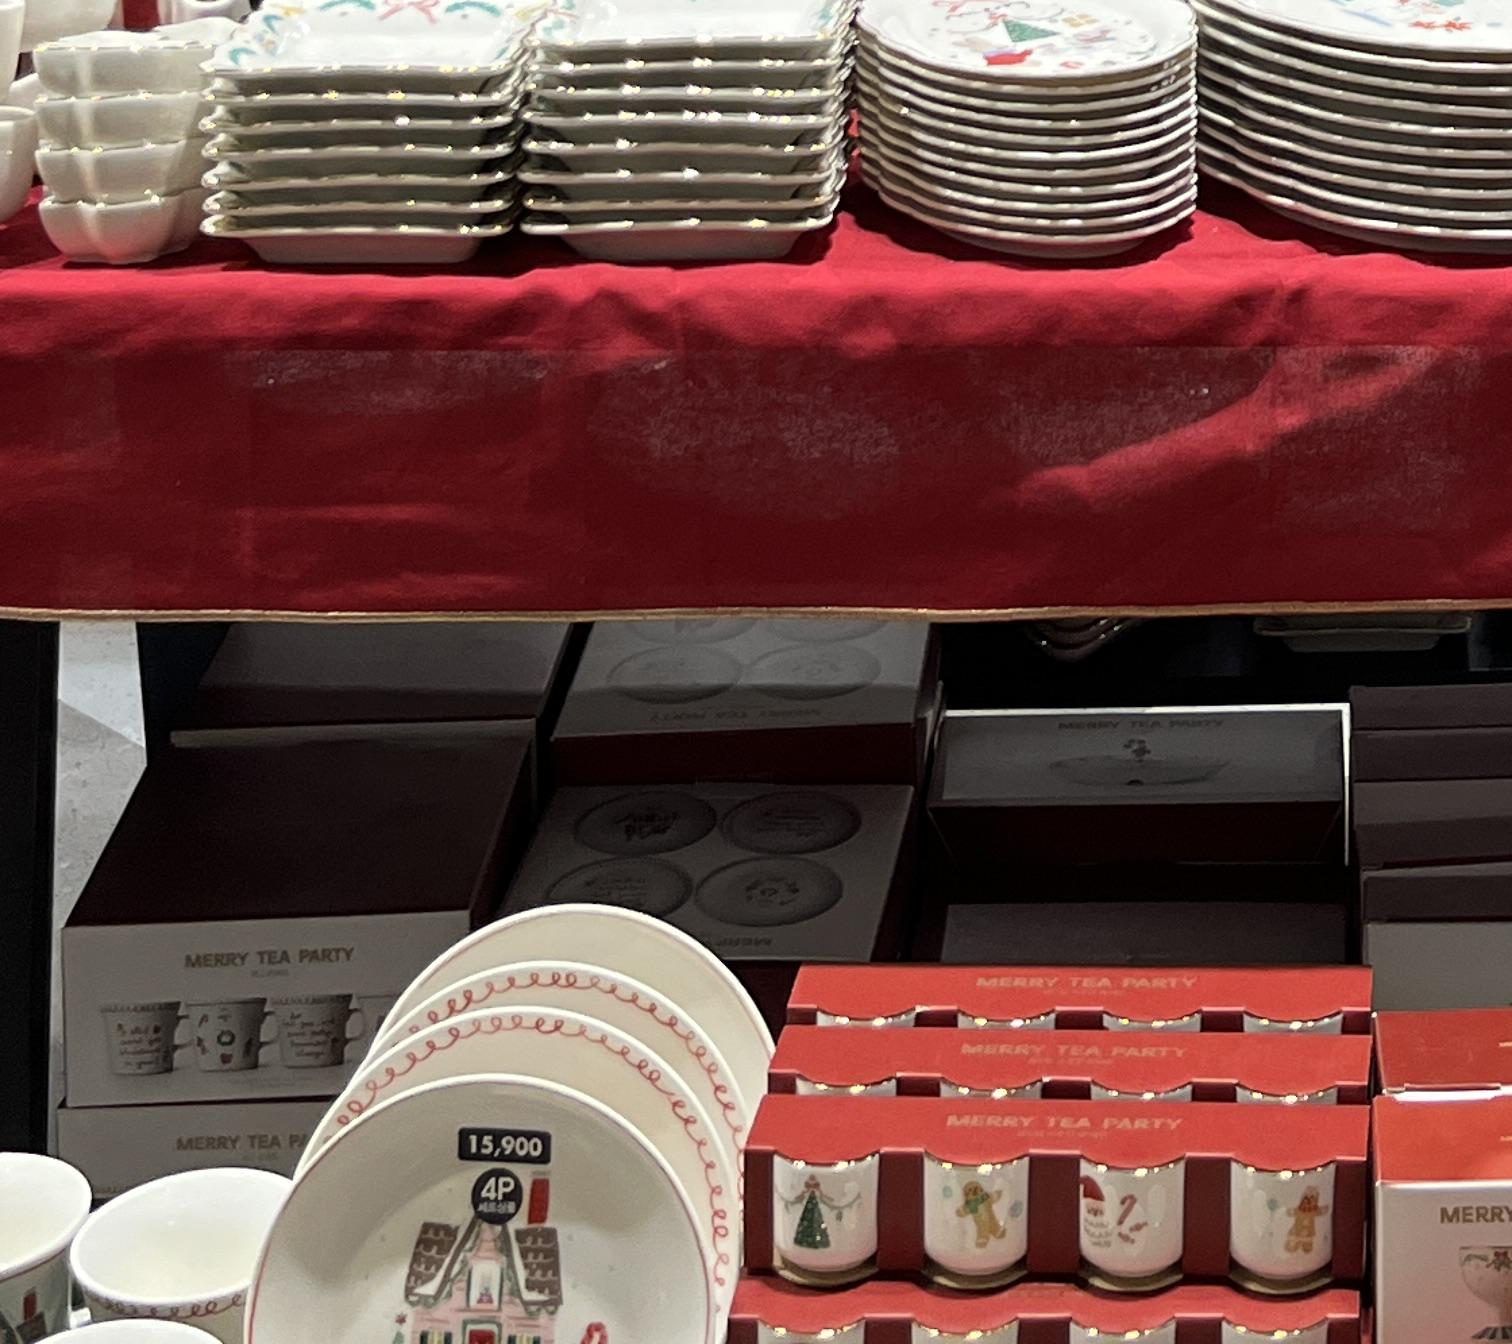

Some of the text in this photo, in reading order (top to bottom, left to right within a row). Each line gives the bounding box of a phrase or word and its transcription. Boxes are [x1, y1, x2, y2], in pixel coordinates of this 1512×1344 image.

[184, 947, 355, 968] MERRY TEA PARTY
[976, 975, 1198, 989] MERRY TEA PARTY
[961, 1043, 1190, 1058] MERRY TEA PARTY
[946, 1113, 1184, 1130] MERRY TEA PARTY
[176, 1135, 240, 1151] MERRY
[249, 1134, 281, 1150] TEA
[469, 1135, 543, 1157] 15,900
[480, 1176, 516, 1201] 4P
